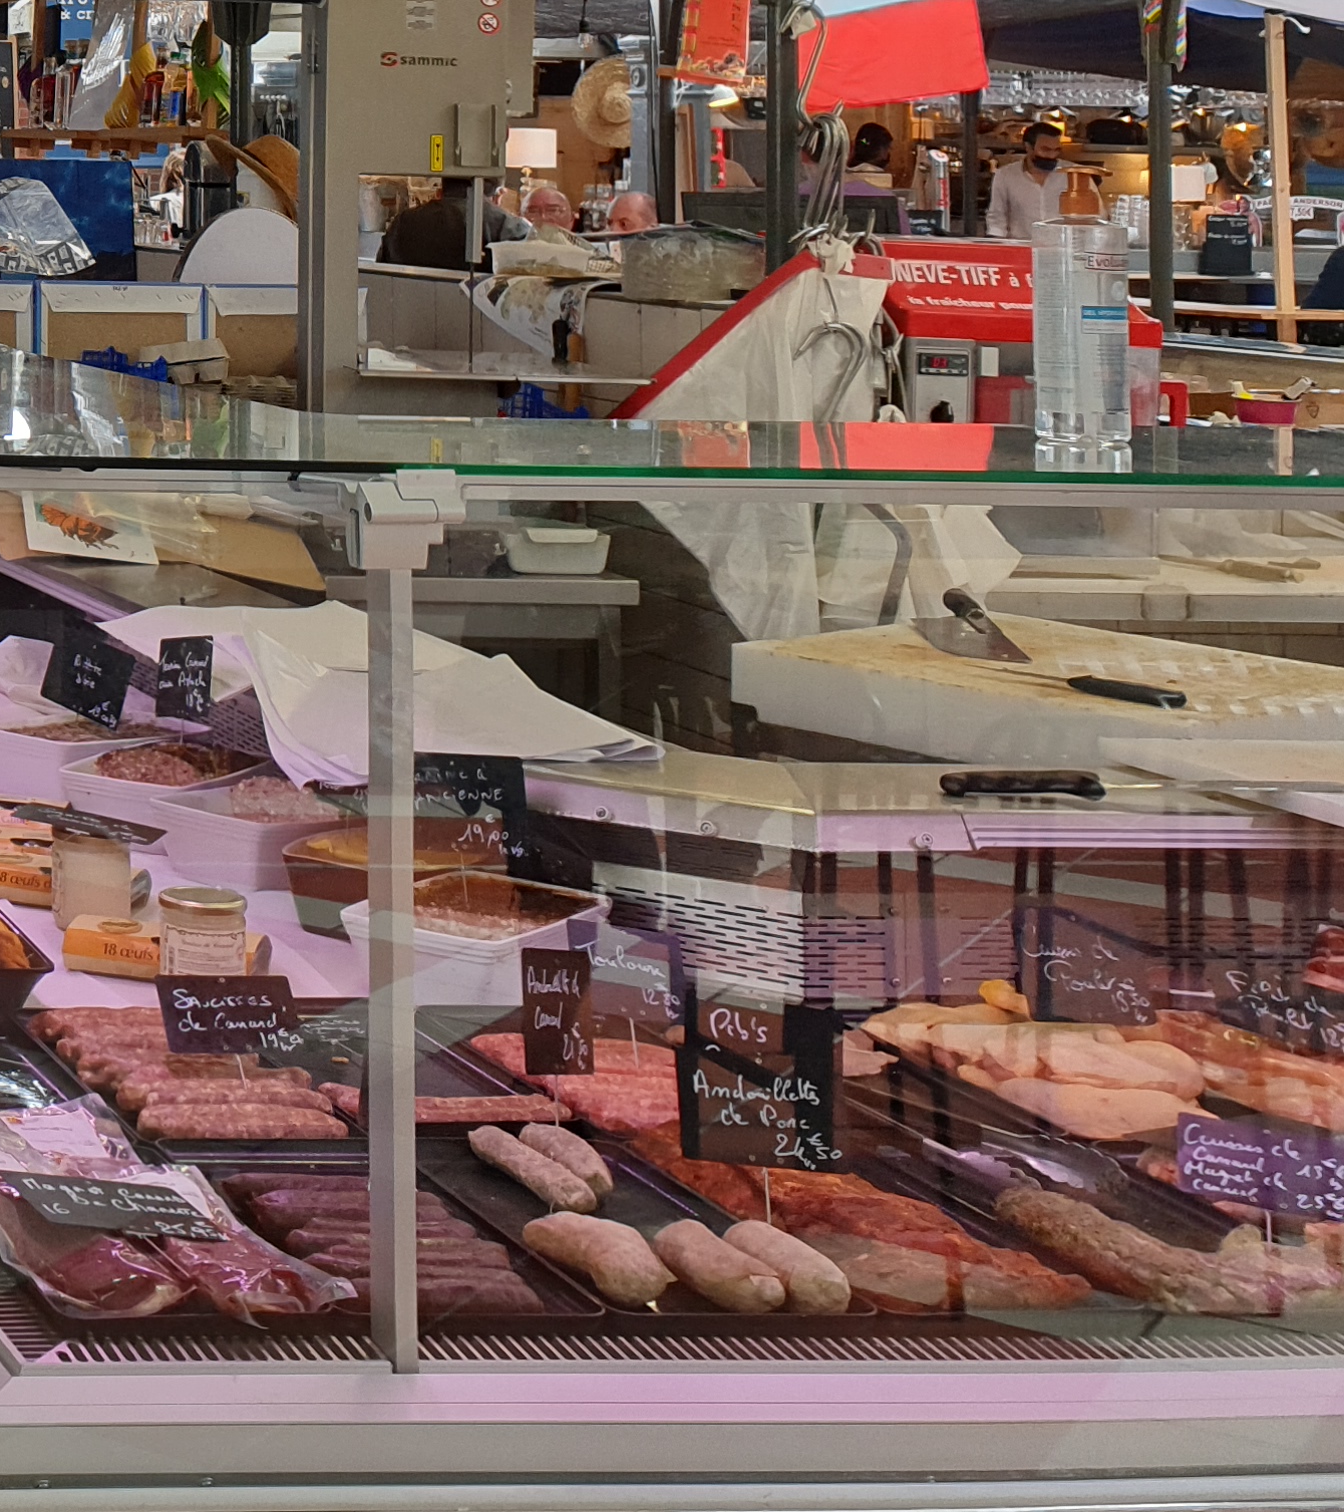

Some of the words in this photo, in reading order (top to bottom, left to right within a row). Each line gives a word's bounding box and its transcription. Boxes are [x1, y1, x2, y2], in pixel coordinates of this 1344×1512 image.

[399, 53, 458, 68] sammic
[102, 943, 117, 957] 18
[178, 1010, 208, 1033] de
[214, 1011, 277, 1031] Canard
[720, 1102, 750, 1127] de
